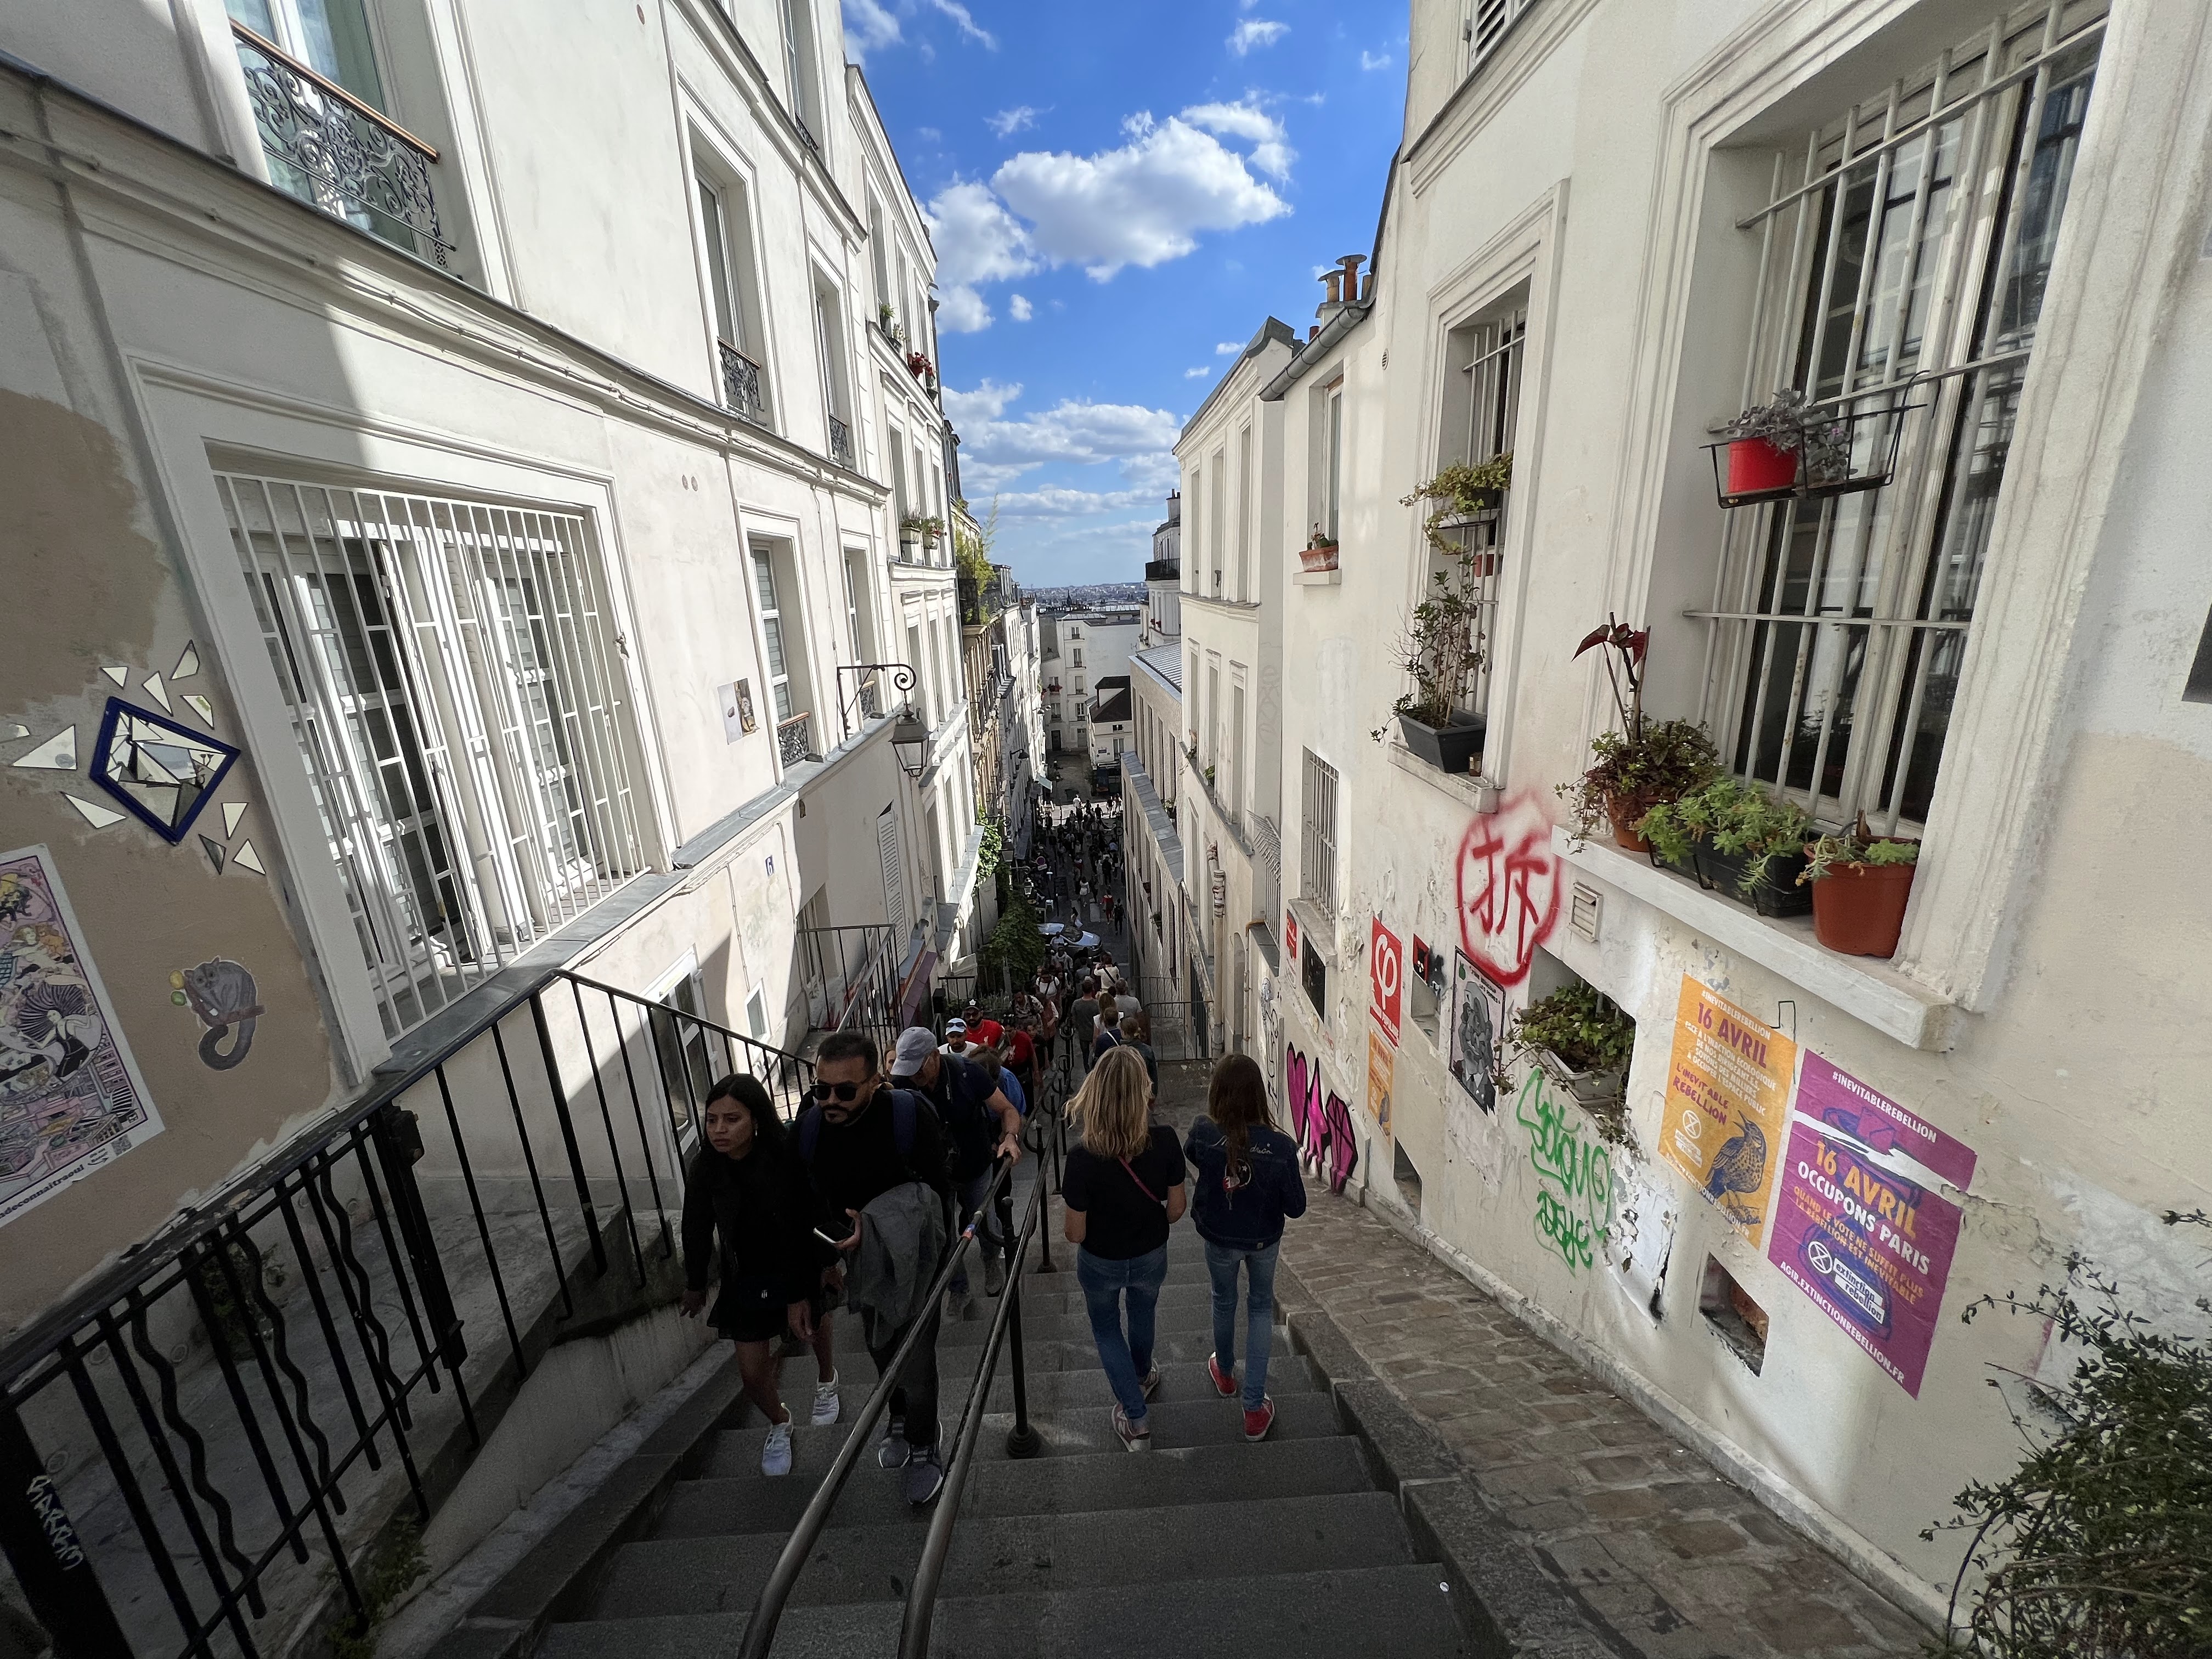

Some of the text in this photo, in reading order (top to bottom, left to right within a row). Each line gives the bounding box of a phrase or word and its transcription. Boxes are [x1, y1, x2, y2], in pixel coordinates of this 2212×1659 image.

[1698, 1002, 1767, 1069] 16 AVRIL
[1701, 990, 1771, 1040] #INEVITABLEREBELLION
[1697, 1039, 1703, 1048] DE
[1705, 1043, 1717, 1058] NOS
[1719, 1065, 1730, 1077] DES
[1718, 1076, 1743, 1099] L'ESPACE
[1744, 1095, 1766, 1116] PUBLIC
[1832, 1071, 1937, 1143] #INEVITABLEREBELLION
[1798, 1161, 1930, 1275] OCCUPONS PARIS
[1816, 1140, 1916, 1240] 16 AVRIL
[1795, 1186, 1923, 1298] QUAND LE VOTE NE SUFFIT PLUS
[1796, 1198, 1804, 1210] LA
[1848, 1243, 1863, 1259] EST
[1836, 1263, 1875, 1301] extinction
[1845, 1283, 1882, 1321] rebellion
[1780, 1261, 1904, 1384] AGIR.EXTINCTIONREBELLION.FR
